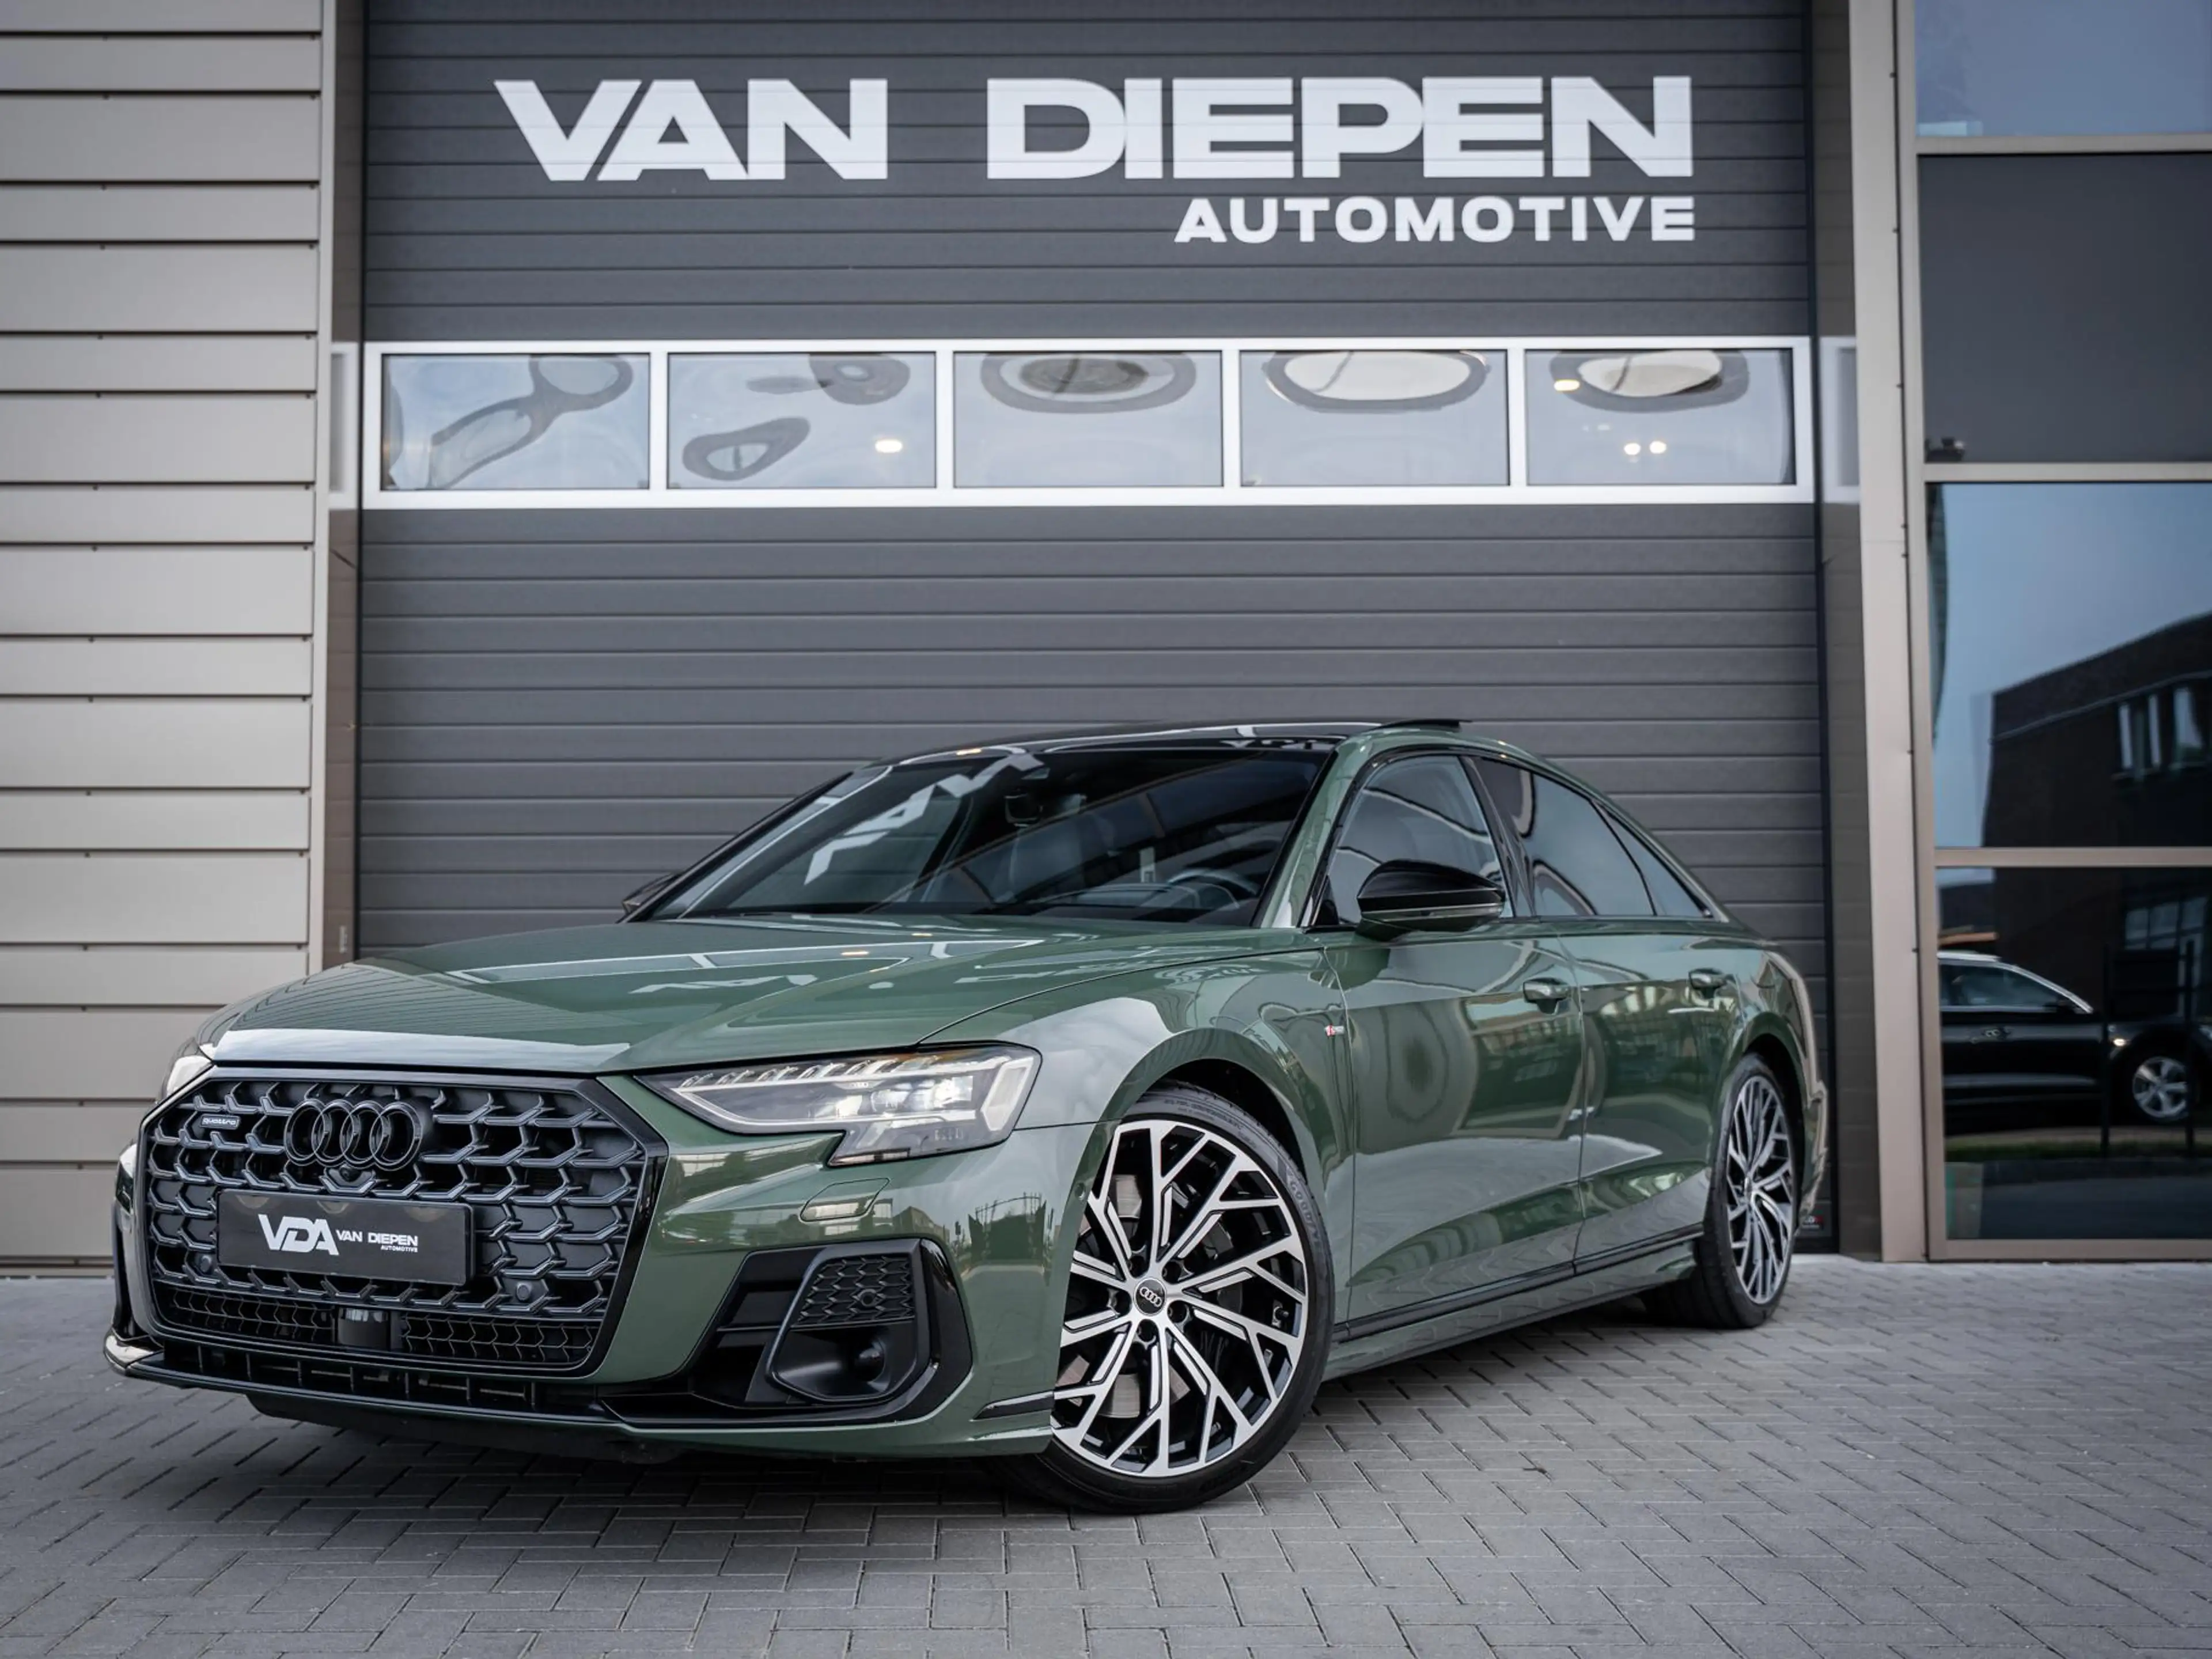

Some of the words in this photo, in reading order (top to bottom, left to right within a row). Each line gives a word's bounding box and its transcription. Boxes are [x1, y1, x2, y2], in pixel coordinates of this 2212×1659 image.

[495, 79, 888, 181] VAN
[987, 77, 1692, 180] DIEPEN
[1175, 197, 1695, 244] AUTOMOTIVE
[258, 1214, 339, 1256] VDA
[336, 1229, 362, 1243] VAN
[368, 1232, 418, 1247] DIEPEN
[380, 1245, 418, 1253] AUTOMOTIVE
